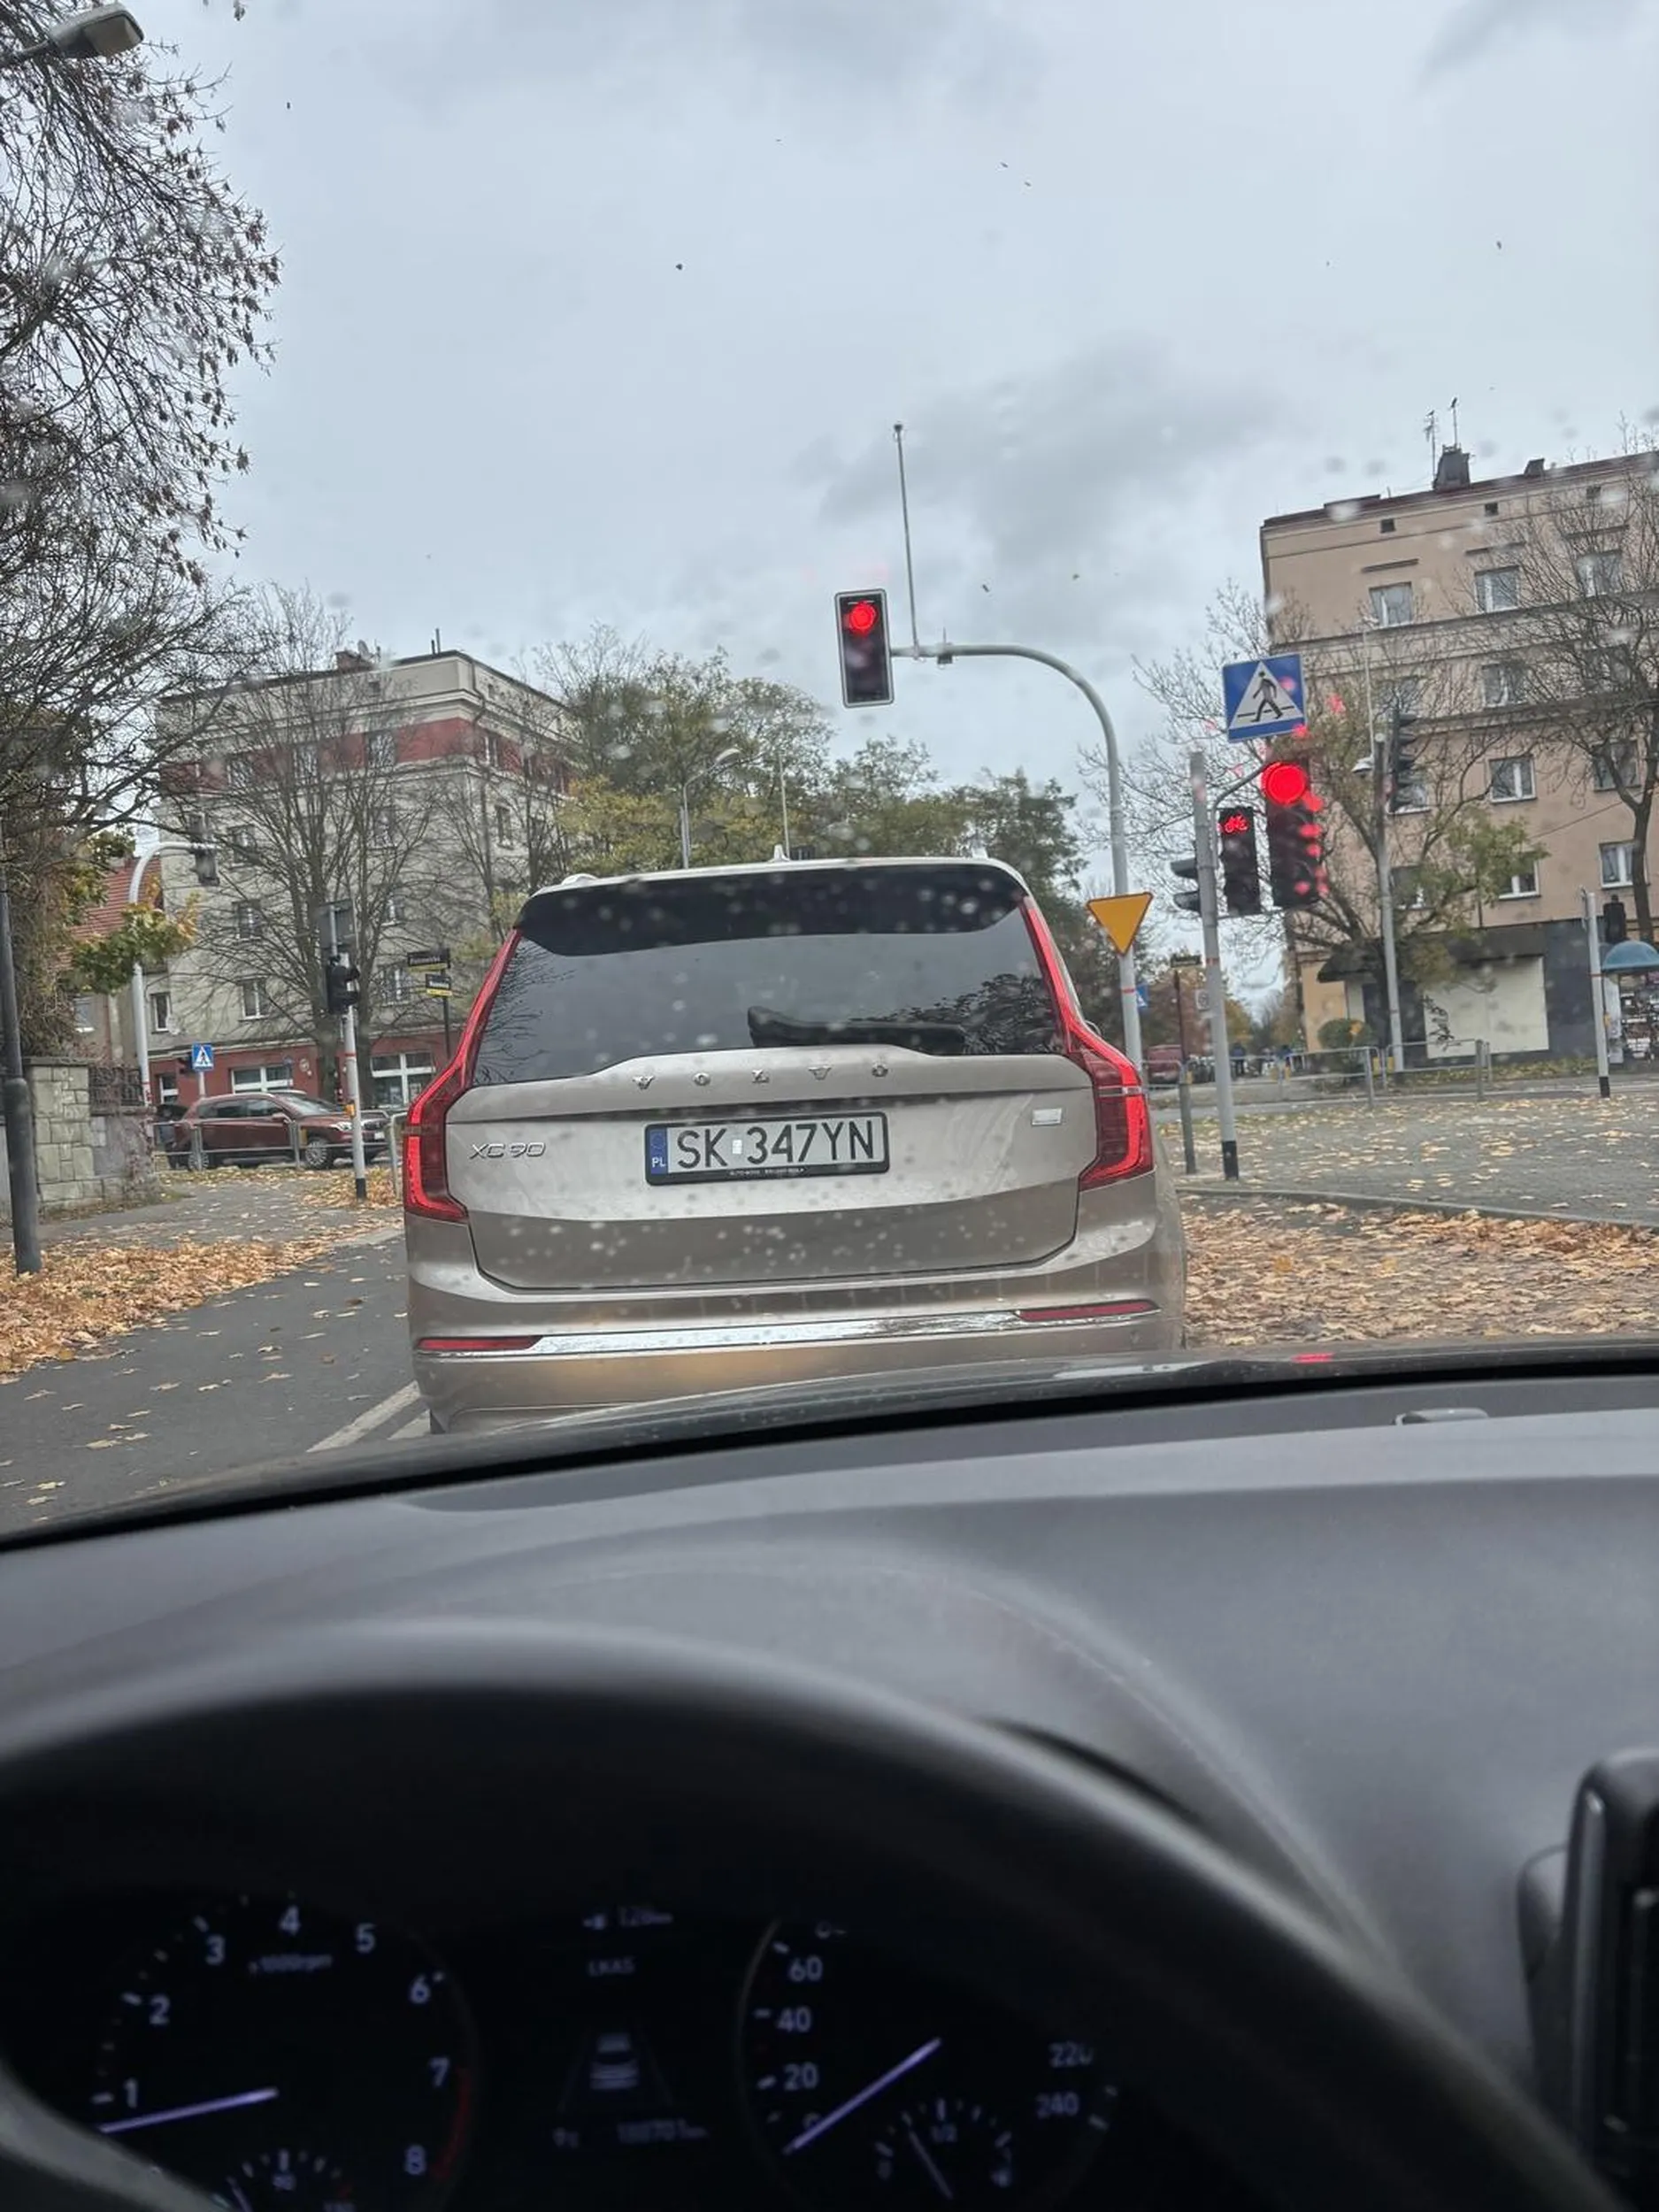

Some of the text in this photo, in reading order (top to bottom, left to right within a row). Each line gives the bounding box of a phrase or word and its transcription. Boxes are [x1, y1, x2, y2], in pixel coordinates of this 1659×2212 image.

[632, 1064, 889, 1091] VOLVO
[677, 1120, 874, 1169] SK 347YN
[651, 1156, 666, 1168] PL
[278, 1905, 302, 1936] 4
[204, 1935, 226, 1966] 3
[355, 1922, 376, 1954] 5
[787, 1955, 823, 1982] 60
[409, 1973, 431, 2004] 6
[150, 1993, 171, 2026] 2
[776, 2005, 812, 2032] 40
[430, 2057, 449, 2086] 7
[783, 2062, 818, 2091] 20
[124, 2079, 138, 2108] 1
[1034, 2092, 1079, 2120] 240
[404, 2143, 426, 2176] 8
